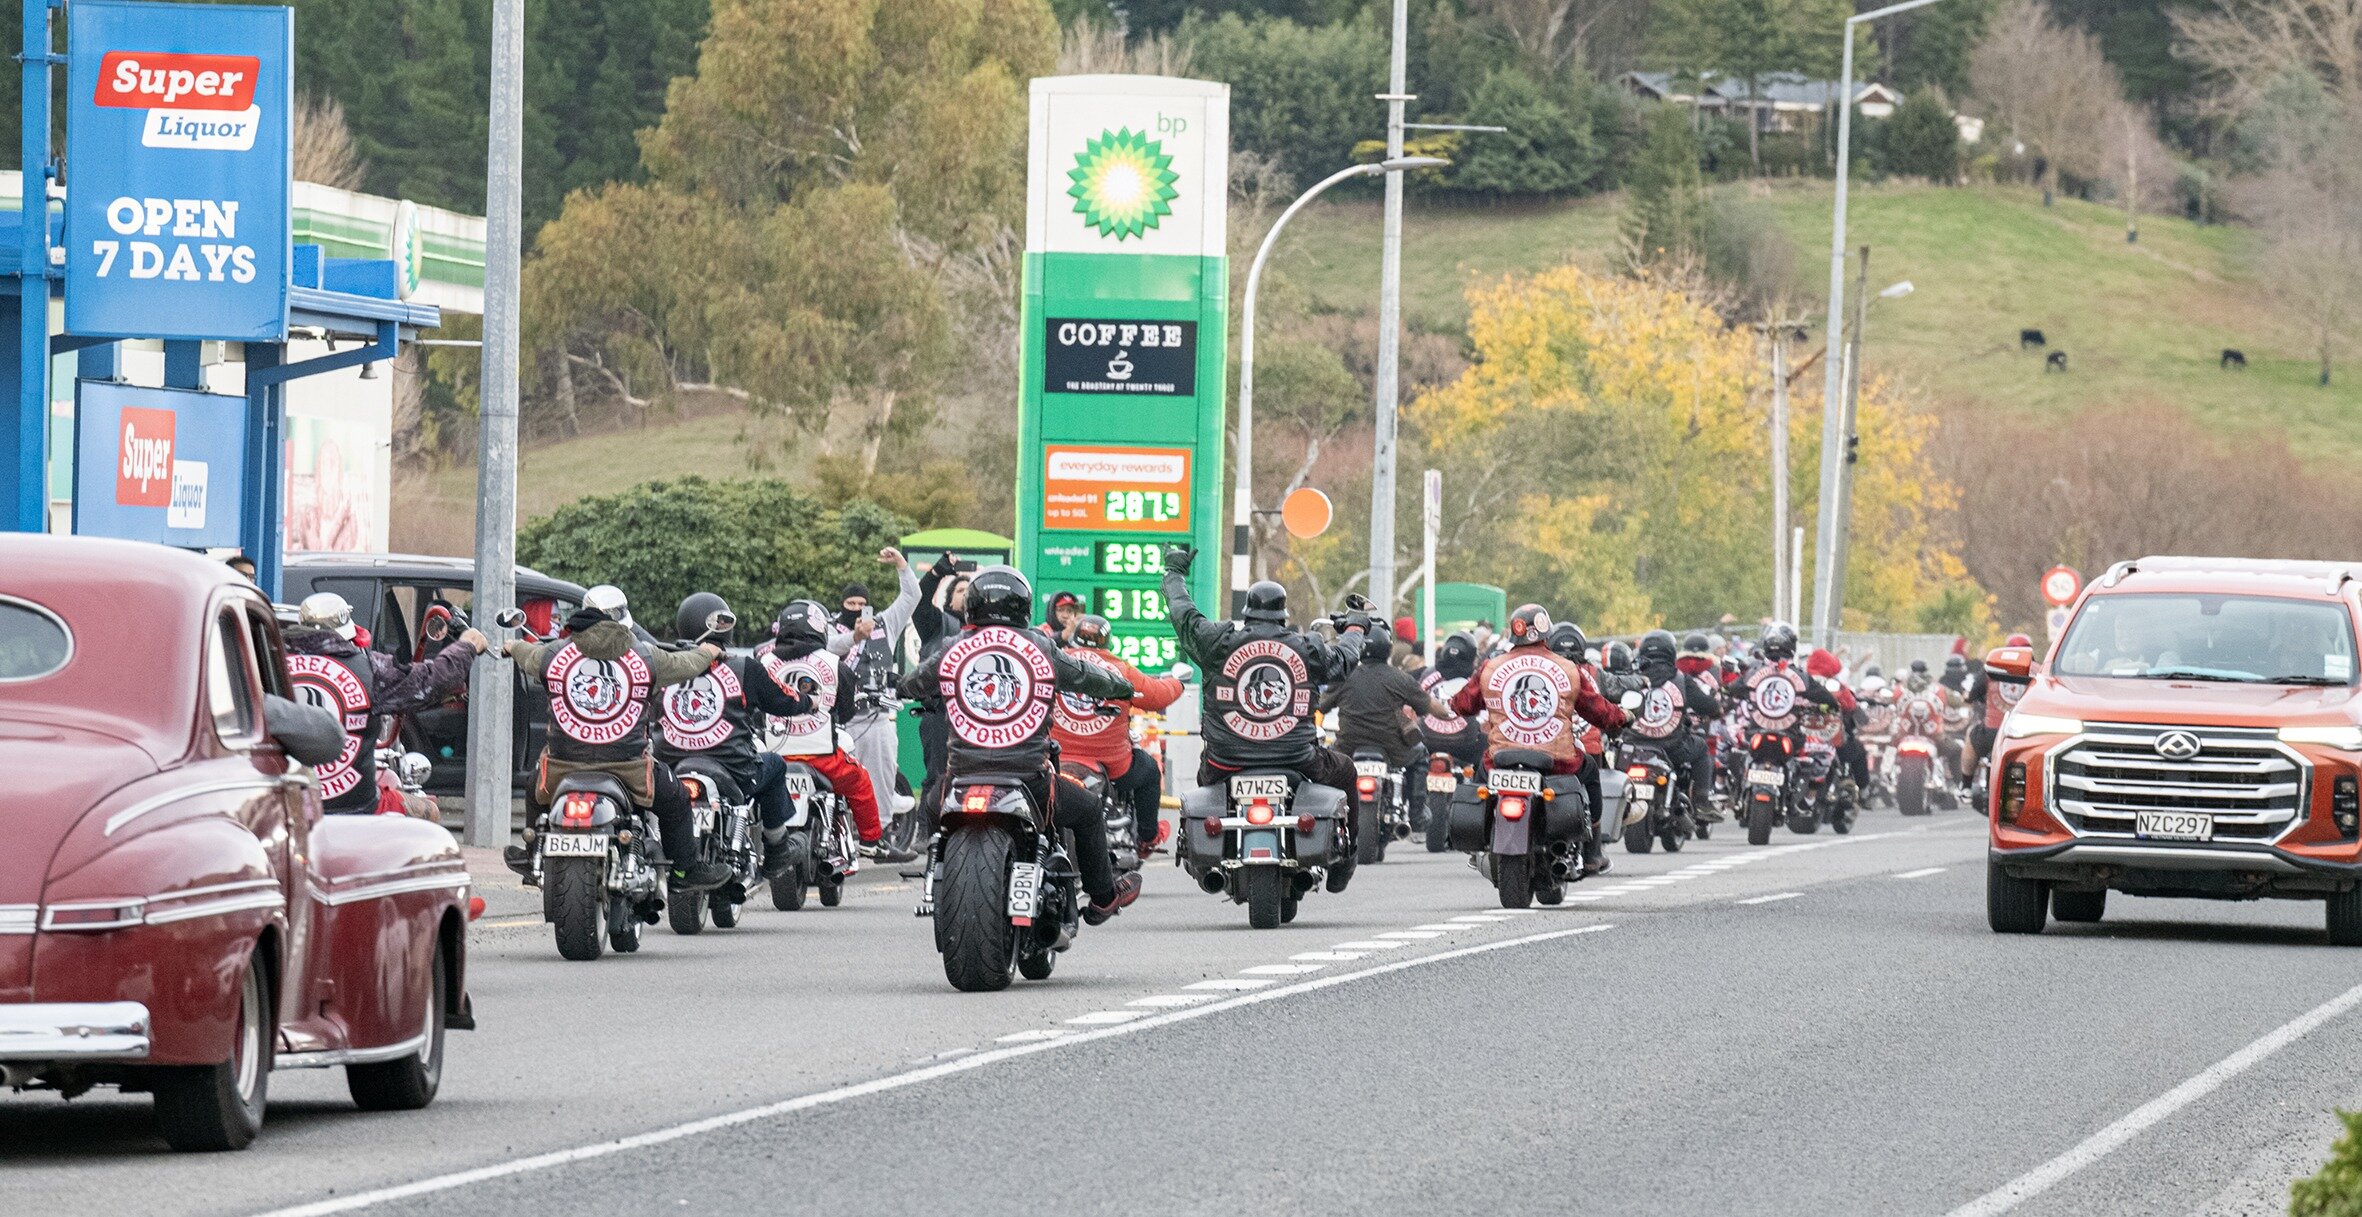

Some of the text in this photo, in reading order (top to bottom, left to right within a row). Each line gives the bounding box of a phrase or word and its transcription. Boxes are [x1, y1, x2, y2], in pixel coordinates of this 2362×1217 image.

[113, 60, 243, 102] Super
[157, 116, 246, 141] Liquor
[1158, 111, 1187, 138] bp
[107, 196, 239, 238] OPEN
[93, 240, 257, 284] 7 DAYS
[1058, 323, 1182, 347] COFFEE
[122, 422, 171, 494] Super
[1060, 461, 1173, 473] everyday rewards
[173, 475, 203, 517] Liquor
[1047, 493, 1086, 503] unleaded
[1107, 491, 1180, 522] 287.9
[1047, 509, 1059, 518] up
[1060, 509, 1071, 517] to
[1044, 547, 1089, 557] unleaded
[1105, 543, 1177, 574] 293.
[815, 660, 834, 683] MOB
[1226, 642, 1306, 681] MONGREL MOB
[717, 665, 739, 693] MOB
[1053, 704, 1112, 734] OTORIOU
[1230, 715, 1293, 738] RIDERS
[661, 720, 714, 747] CENTRAL
[1504, 721, 1559, 744] RIDERS
[1357, 764, 1384, 774] WTY
[1235, 779, 1284, 795] A7WZS
[1491, 774, 1537, 790] C6CEK
[2138, 814, 2209, 834] NZC297
[549, 837, 604, 852] B6AJM
